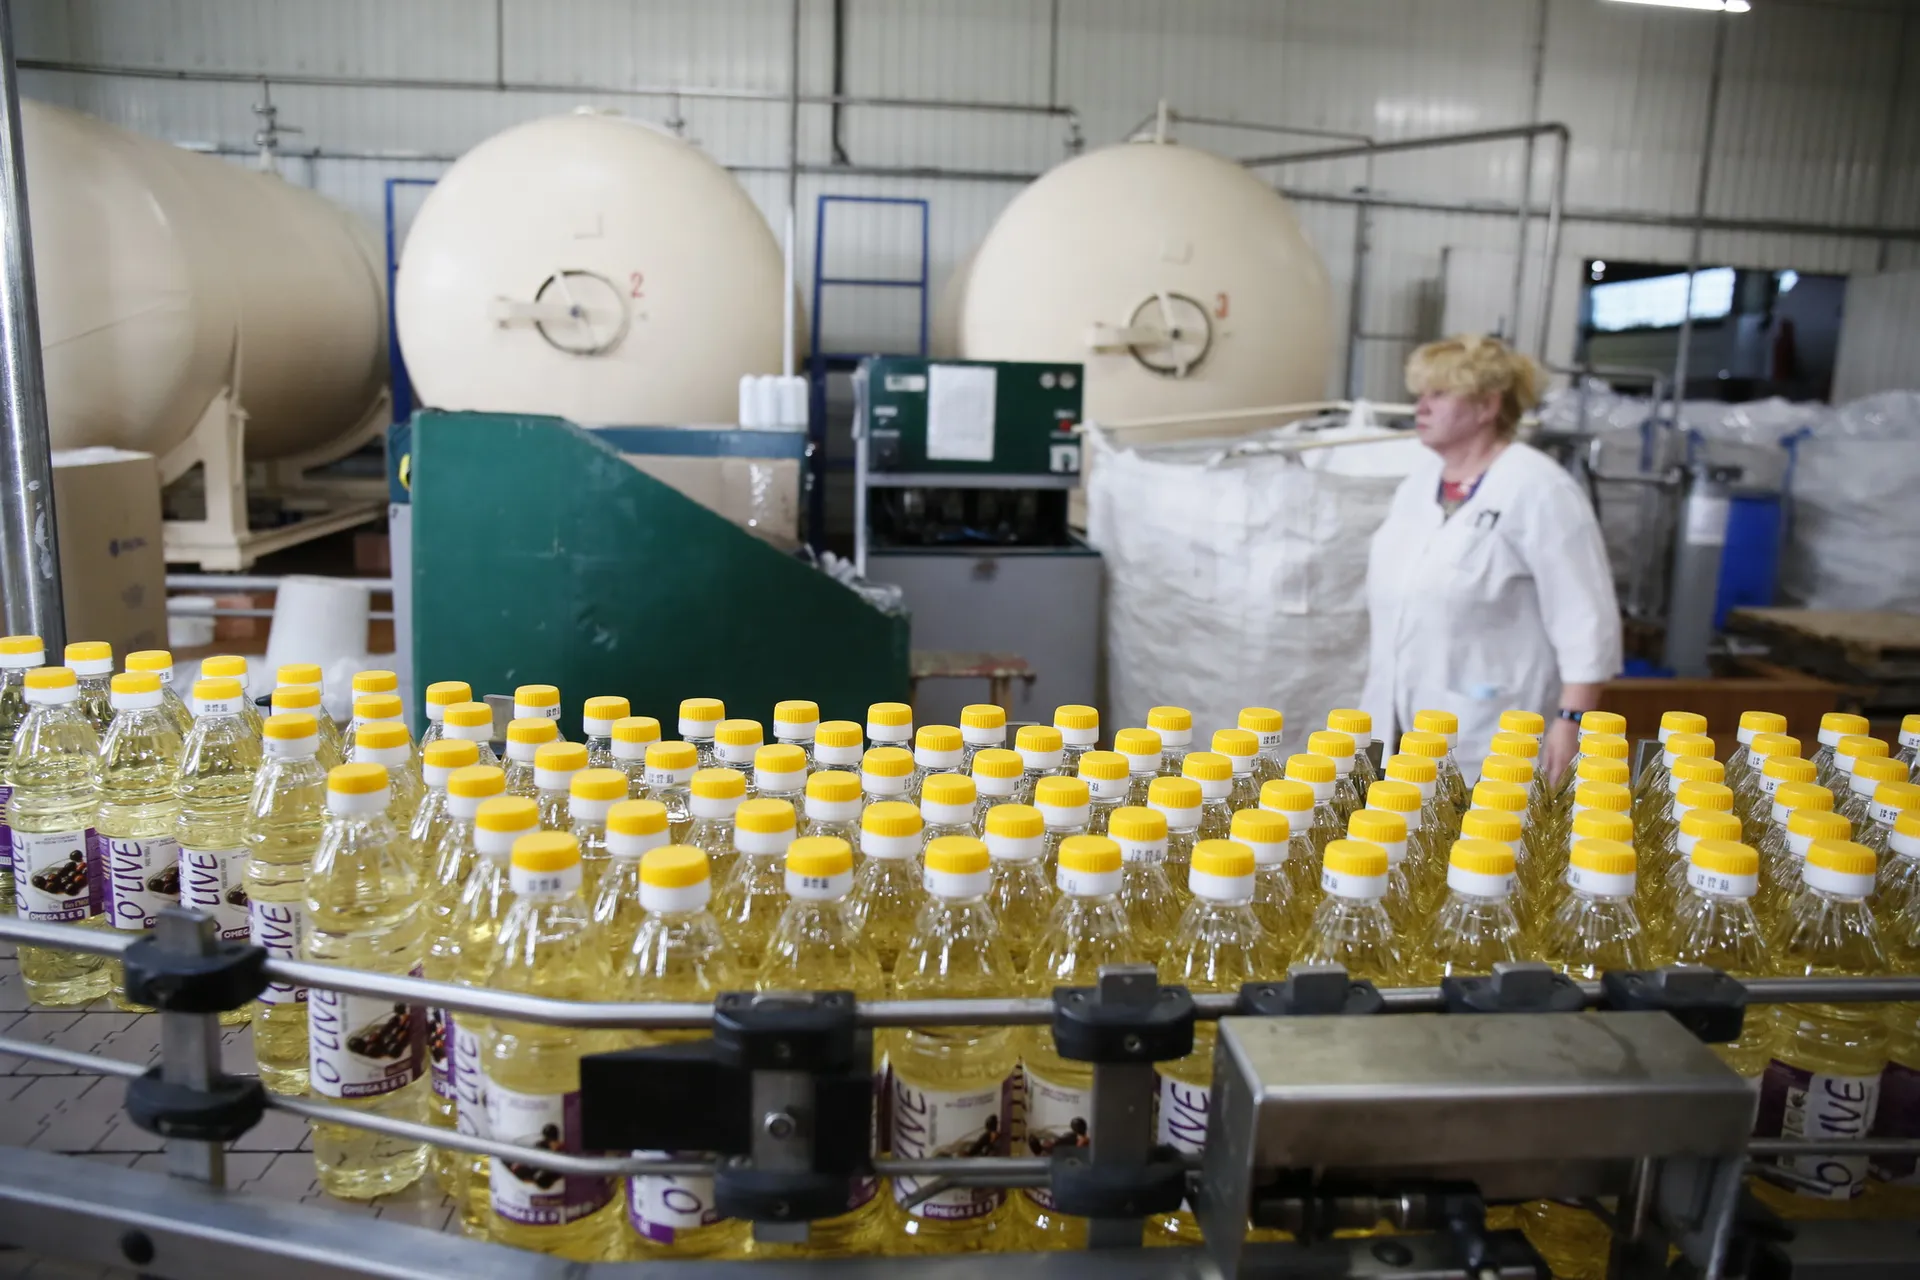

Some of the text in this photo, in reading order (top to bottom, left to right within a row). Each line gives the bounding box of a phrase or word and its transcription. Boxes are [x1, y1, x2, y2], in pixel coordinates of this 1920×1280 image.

[630, 272, 645, 299] 2
[112, 840, 146, 920] O'LIVE
[189, 852, 221, 932] LIVE
[30, 913, 59, 921] OMEGA
[223, 927, 250, 939] OMEG
[1815, 1079, 1865, 1187] OIVE
